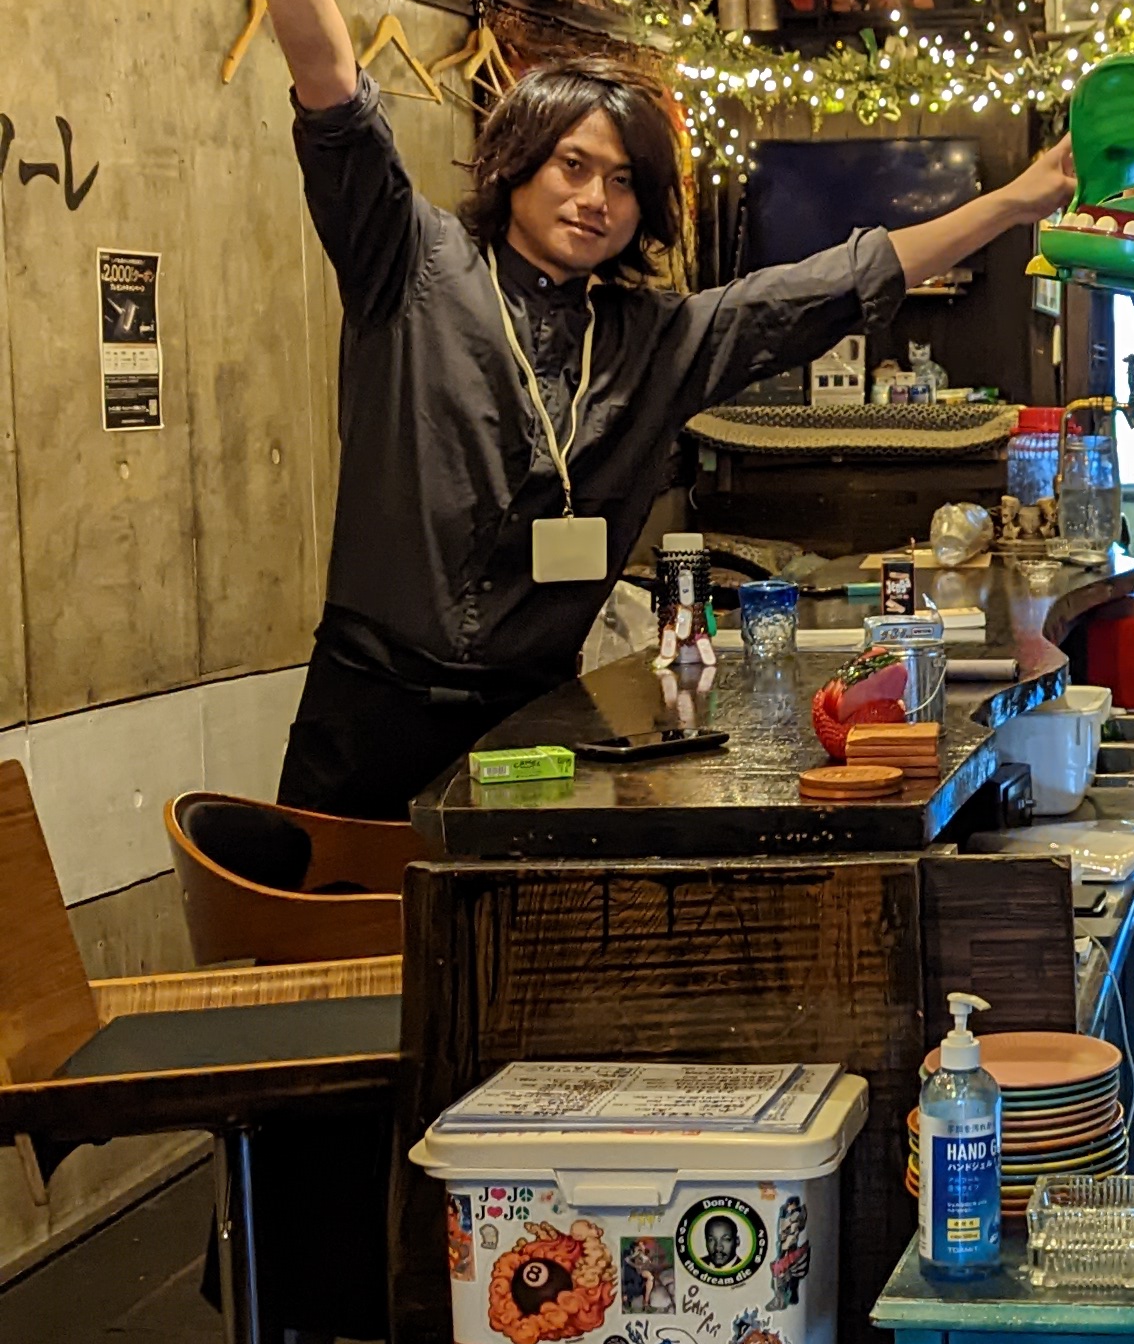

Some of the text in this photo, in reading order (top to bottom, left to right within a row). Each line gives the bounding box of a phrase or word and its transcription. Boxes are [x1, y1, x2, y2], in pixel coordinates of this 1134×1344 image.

[946, 1141, 987, 1161] HAND
[702, 1197, 750, 1216] Don't let
[523, 1264, 543, 1288] 8
[683, 1258, 753, 1285] the dream die
